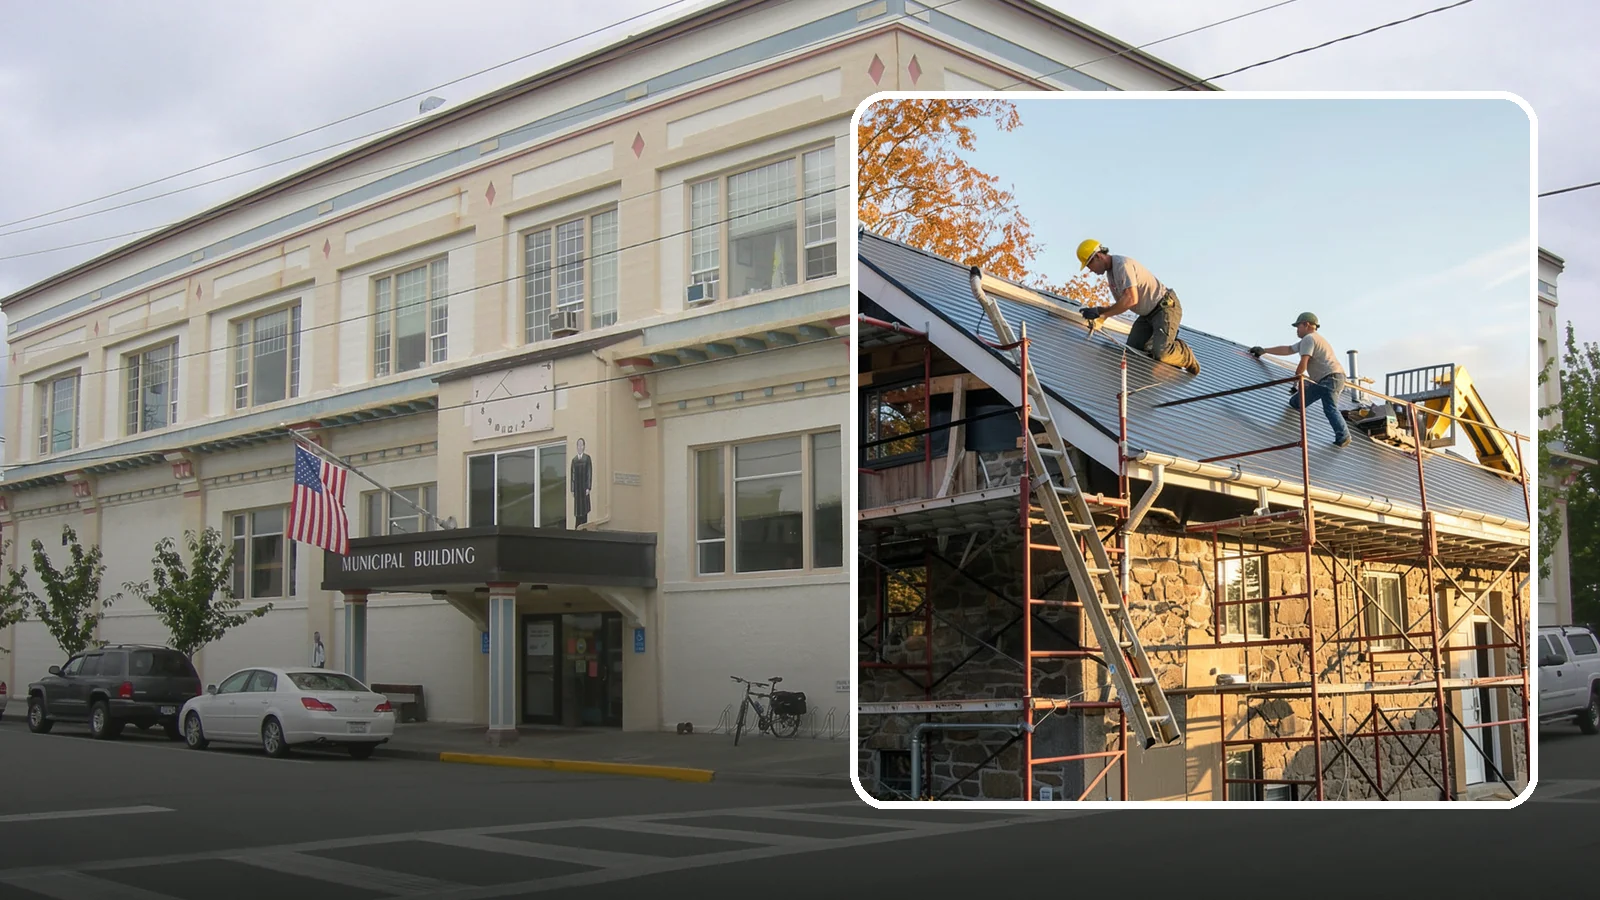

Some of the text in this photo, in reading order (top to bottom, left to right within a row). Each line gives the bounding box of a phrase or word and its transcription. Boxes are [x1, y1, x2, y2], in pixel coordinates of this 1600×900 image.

[536, 402, 540, 410] 4
[480, 407, 485, 415] 8
[488, 417, 492, 426] 9
[528, 414, 533, 422] 3
[494, 423, 500, 432] 10
[521, 420, 525, 428] 2
[501, 425, 506, 433] 11
[507, 425, 513, 433] 12
[342, 546, 475, 571] MUNICIPAL BUILDING
